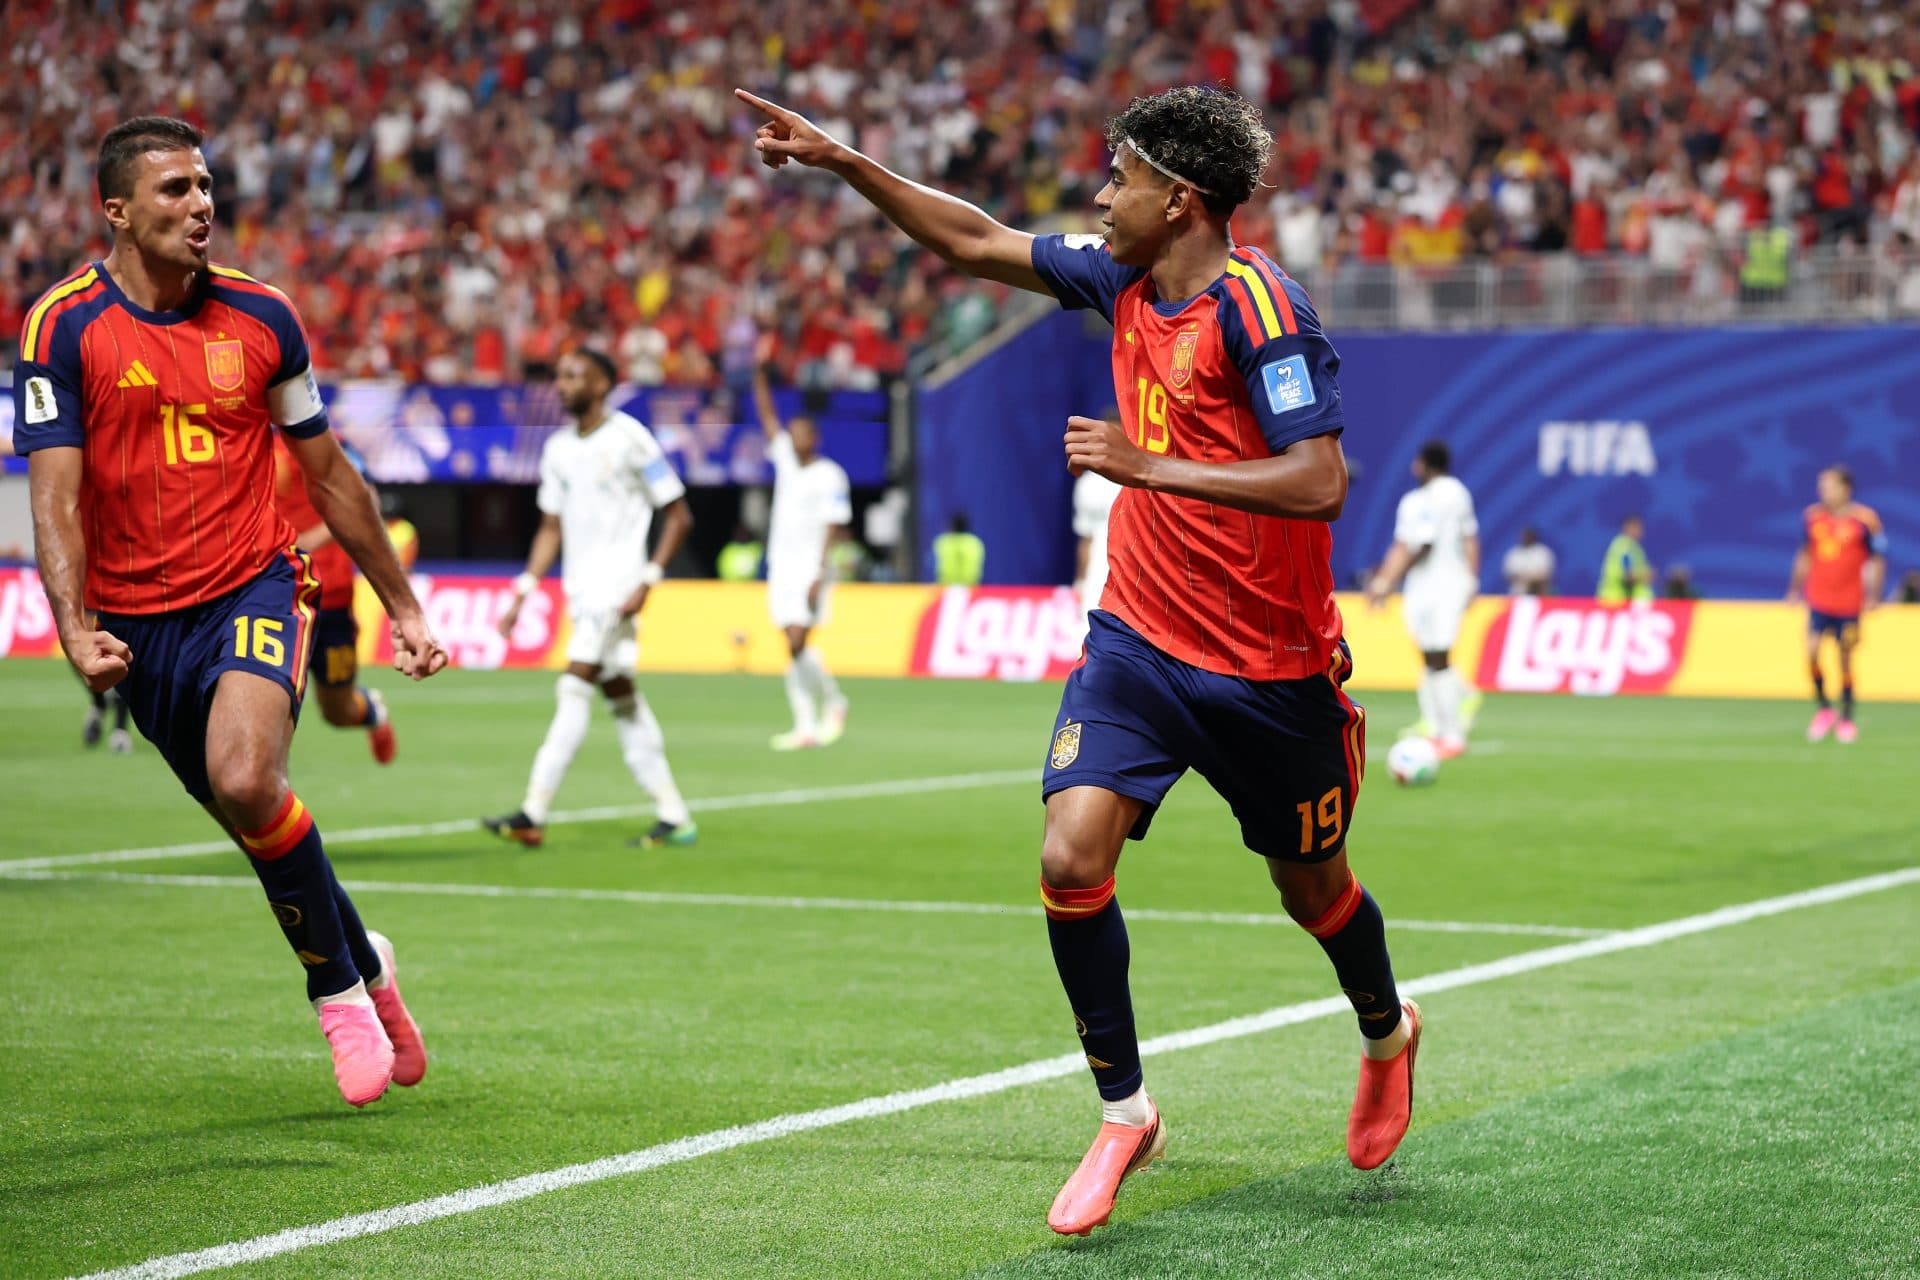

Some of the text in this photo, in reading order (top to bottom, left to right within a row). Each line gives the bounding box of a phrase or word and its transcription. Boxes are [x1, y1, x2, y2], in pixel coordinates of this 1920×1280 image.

[160, 403, 215, 465] 16
[1138, 376, 1169, 454] 19
[1539, 421, 1657, 477] FIFA
[233, 615, 285, 667] 16
[1296, 786, 1343, 854] 19
